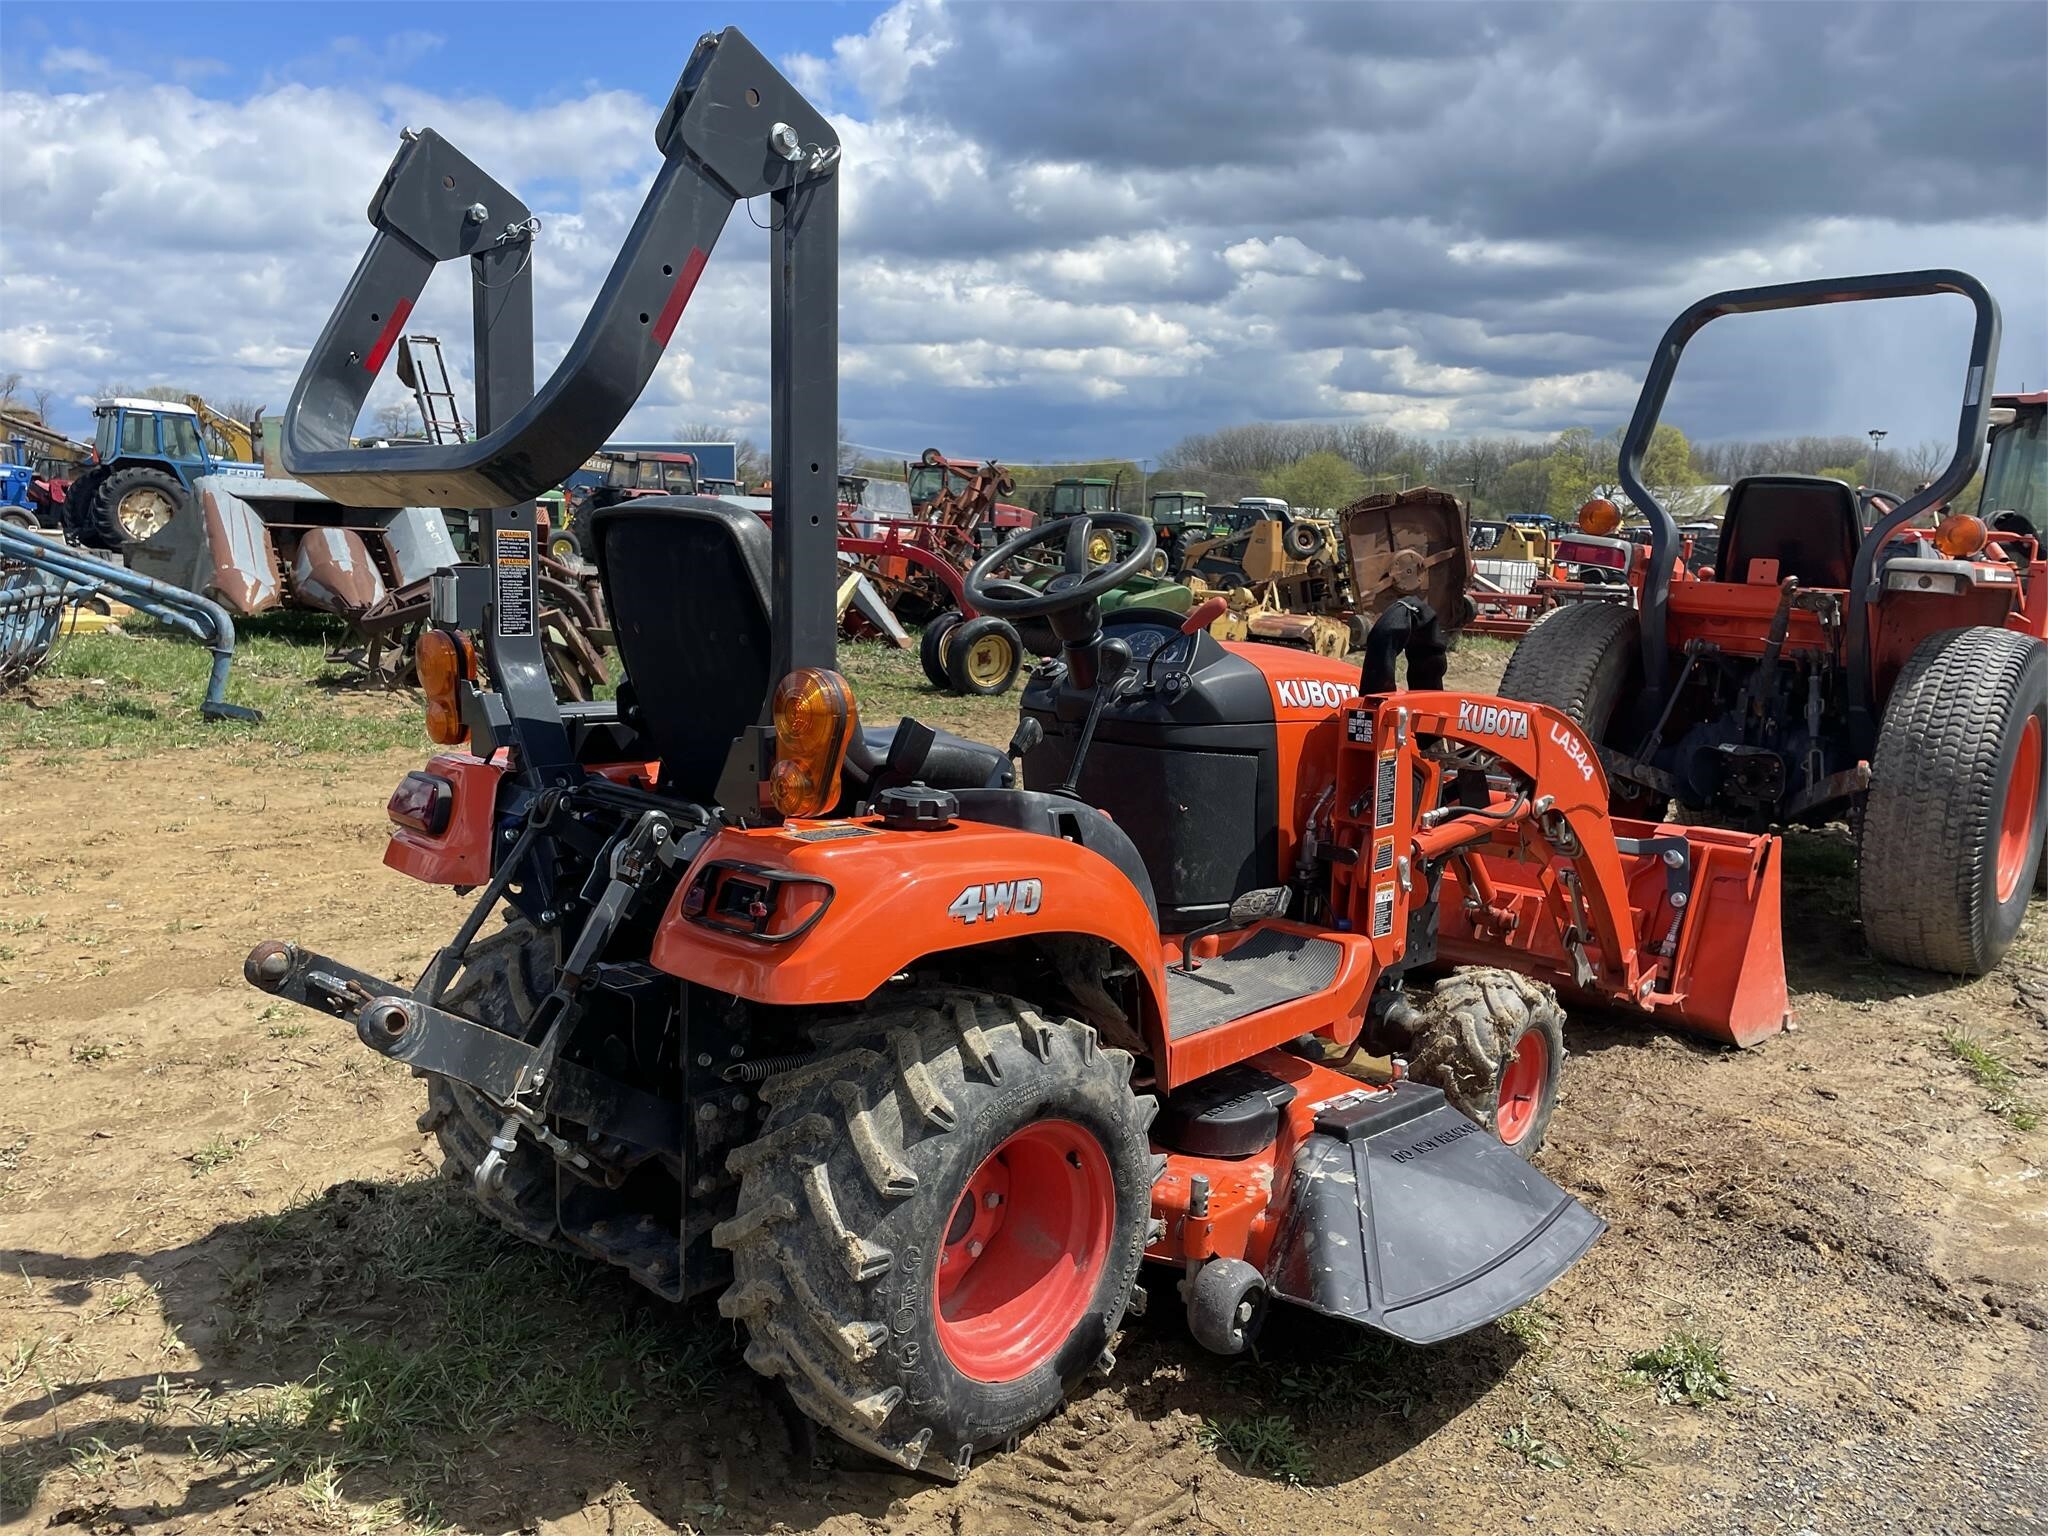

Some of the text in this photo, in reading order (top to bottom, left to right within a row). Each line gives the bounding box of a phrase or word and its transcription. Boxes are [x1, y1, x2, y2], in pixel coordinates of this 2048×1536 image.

[1457, 700, 1528, 740] KUBOTA
[1550, 721, 1594, 781] LA344
[947, 878, 1042, 925] 4WD
[1391, 1122, 1480, 1163] DO NOT REMOVE
